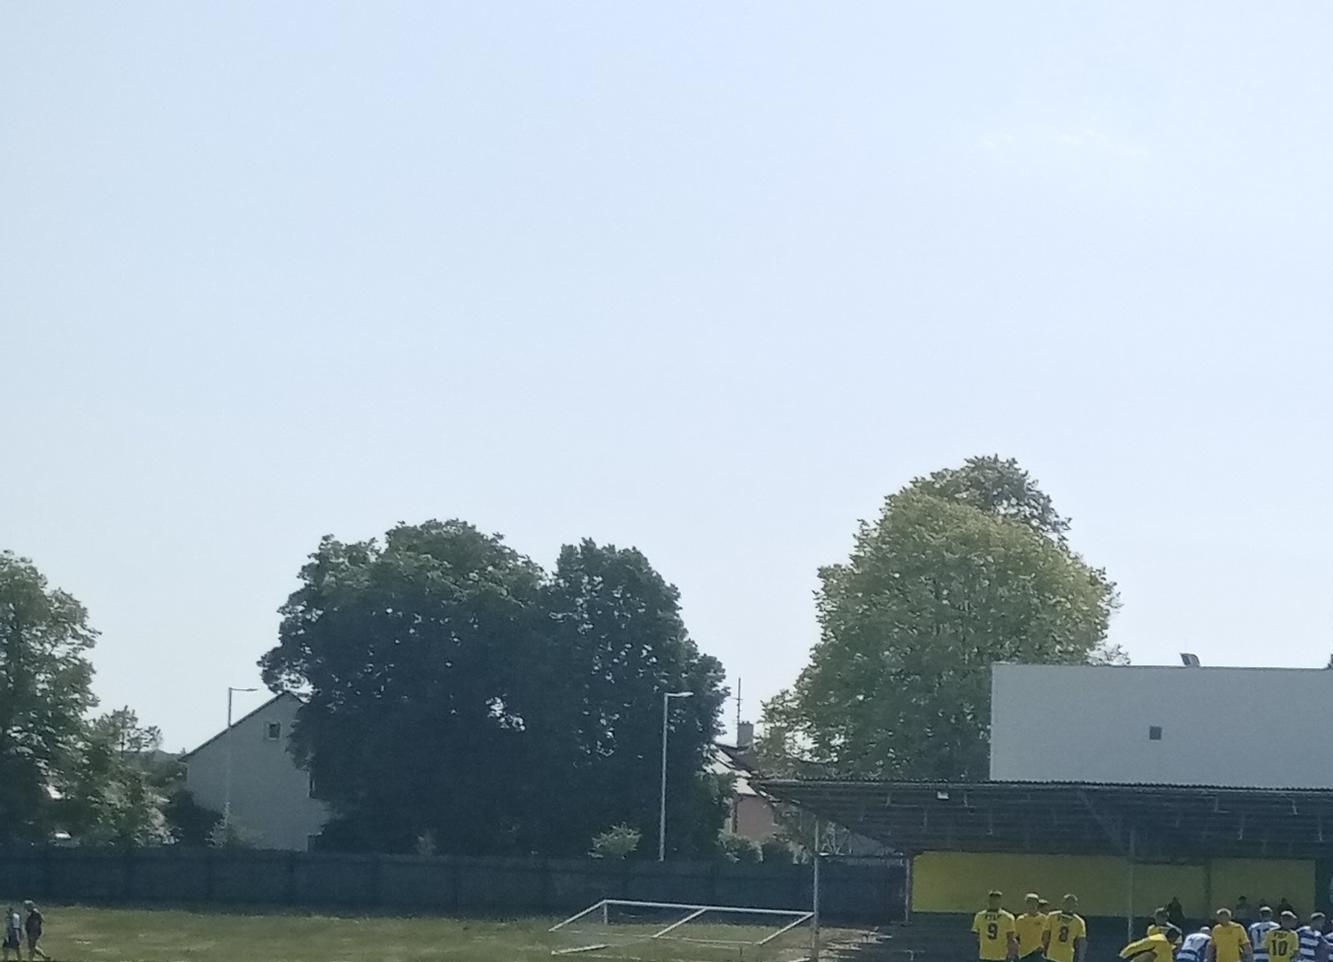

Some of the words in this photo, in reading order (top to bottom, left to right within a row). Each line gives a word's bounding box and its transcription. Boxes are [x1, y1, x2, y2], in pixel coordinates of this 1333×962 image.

[988, 923, 998, 940] 9
[1058, 926, 1069, 942] 8
[1272, 940, 1288, 956] 10
